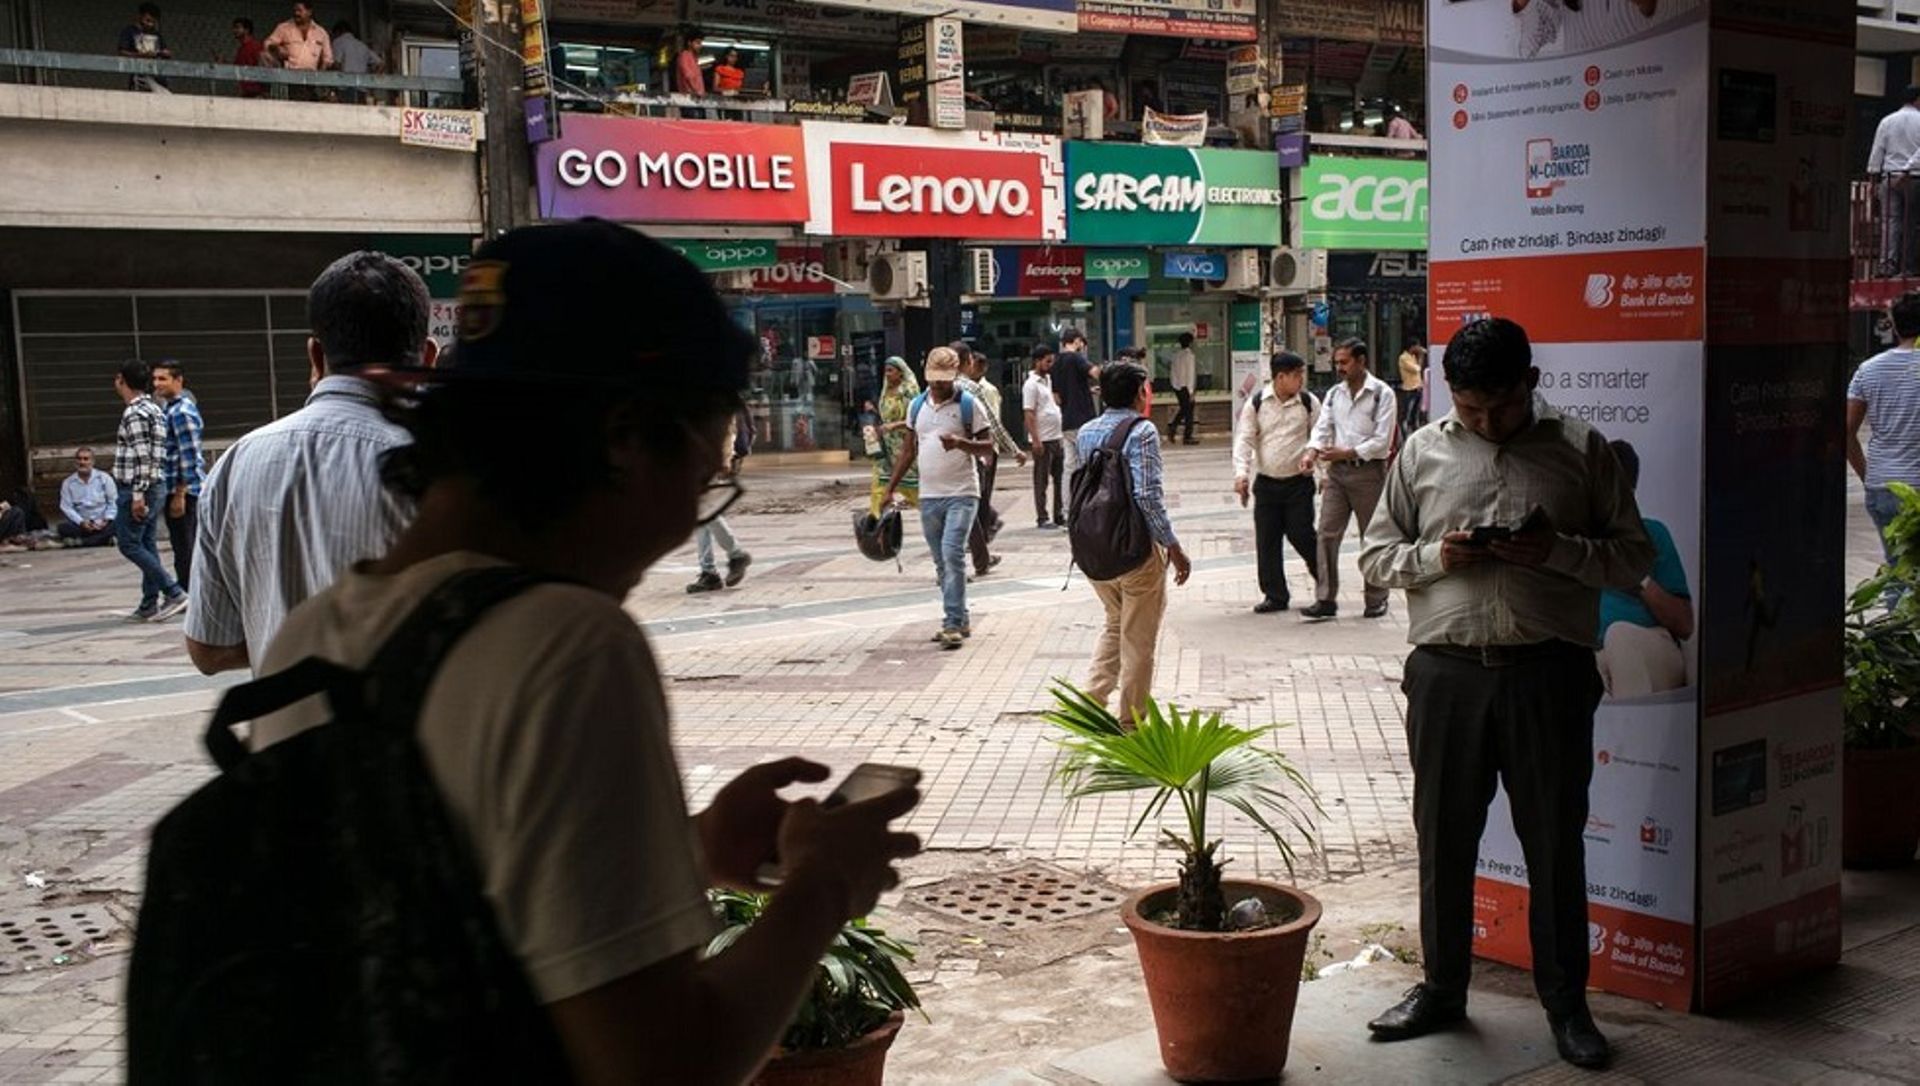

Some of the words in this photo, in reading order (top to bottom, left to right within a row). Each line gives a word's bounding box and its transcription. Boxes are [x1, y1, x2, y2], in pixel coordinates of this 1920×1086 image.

[1495, 83, 1510, 94] fund
[404, 110, 425, 131] SK
[1521, 106, 1535, 117] with
[1552, 144, 1591, 161] BARODA
[558, 148, 627, 187] GO
[638, 151, 796, 190] MOBILE
[1529, 159, 1591, 180] M-CONNECT
[850, 162, 1030, 217] Lenovo
[1074, 172, 1204, 213] SARGAM
[1207, 187, 1283, 206] ELECTRONICS
[1311, 174, 1428, 222] acer
[1530, 205, 1554, 216] Mobile
[1556, 203, 1585, 215] Banking
[1460, 236, 1488, 254] Cash
[1491, 235, 1516, 250] free
[1566, 227, 1614, 245] Bindaas
[706, 245, 767, 263] oppo
[403, 254, 472, 276] opp
[1025, 263, 1082, 277] lenovo
[1092, 256, 1142, 272] oppo
[1176, 258, 1214, 275] vivo
[1620, 292, 1646, 307] Bank
[1647, 292, 1657, 307] of
[1657, 292, 1695, 306] Baroda
[1559, 371, 1572, 389] a
[1576, 367, 1650, 390] smarter
[1487, 858, 1512, 875] free
[1611, 946, 1636, 965] Bank
[1637, 954, 1649, 967] of
[1648, 956, 1686, 977] Baroda
